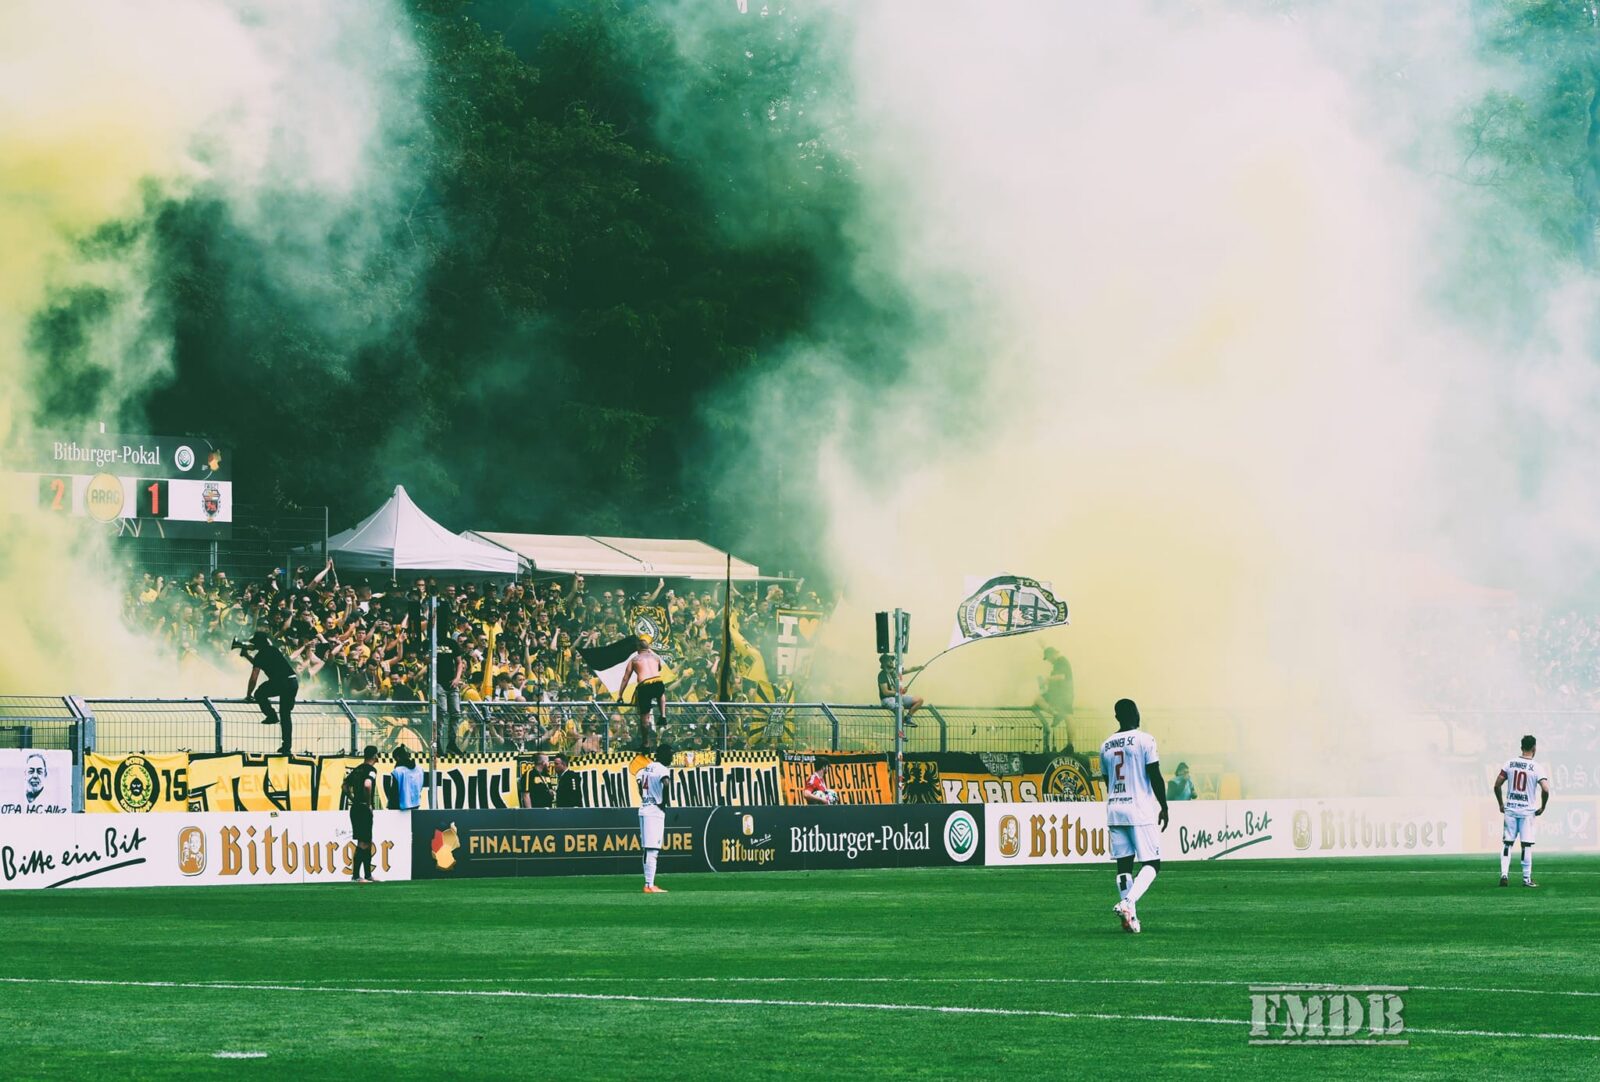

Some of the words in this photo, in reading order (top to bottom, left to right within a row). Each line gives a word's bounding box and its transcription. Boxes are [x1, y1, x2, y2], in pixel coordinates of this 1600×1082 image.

[54, 441, 160, 467] Bitburger-Pokal
[51, 479, 65, 510] 2
[148, 483, 159, 514] 1
[91, 489, 120, 505] ARAG
[1114, 750, 1125, 781] 2
[1513, 770, 1528, 792] 10
[86, 767, 112, 802] 20
[164, 768, 188, 802] 15
[942, 779, 1038, 804] KARLS
[469, 834, 556, 854] FINALTAG
[564, 834, 599, 853] DER
[603, 832, 692, 852] AMAURE
[790, 823, 930, 859] Bitburger-Pokal
[1029, 814, 1109, 858] Bitbu
[1180, 826, 1214, 854] Bitte
[1217, 825, 1243, 841] ein
[1245, 811, 1272, 836] Bit
[1320, 810, 1448, 851] Bitburger
[2, 845, 56, 881] Bitte
[61, 845, 101, 866] ein
[105, 827, 147, 858] Bit
[721, 838, 775, 864] Bitburger
